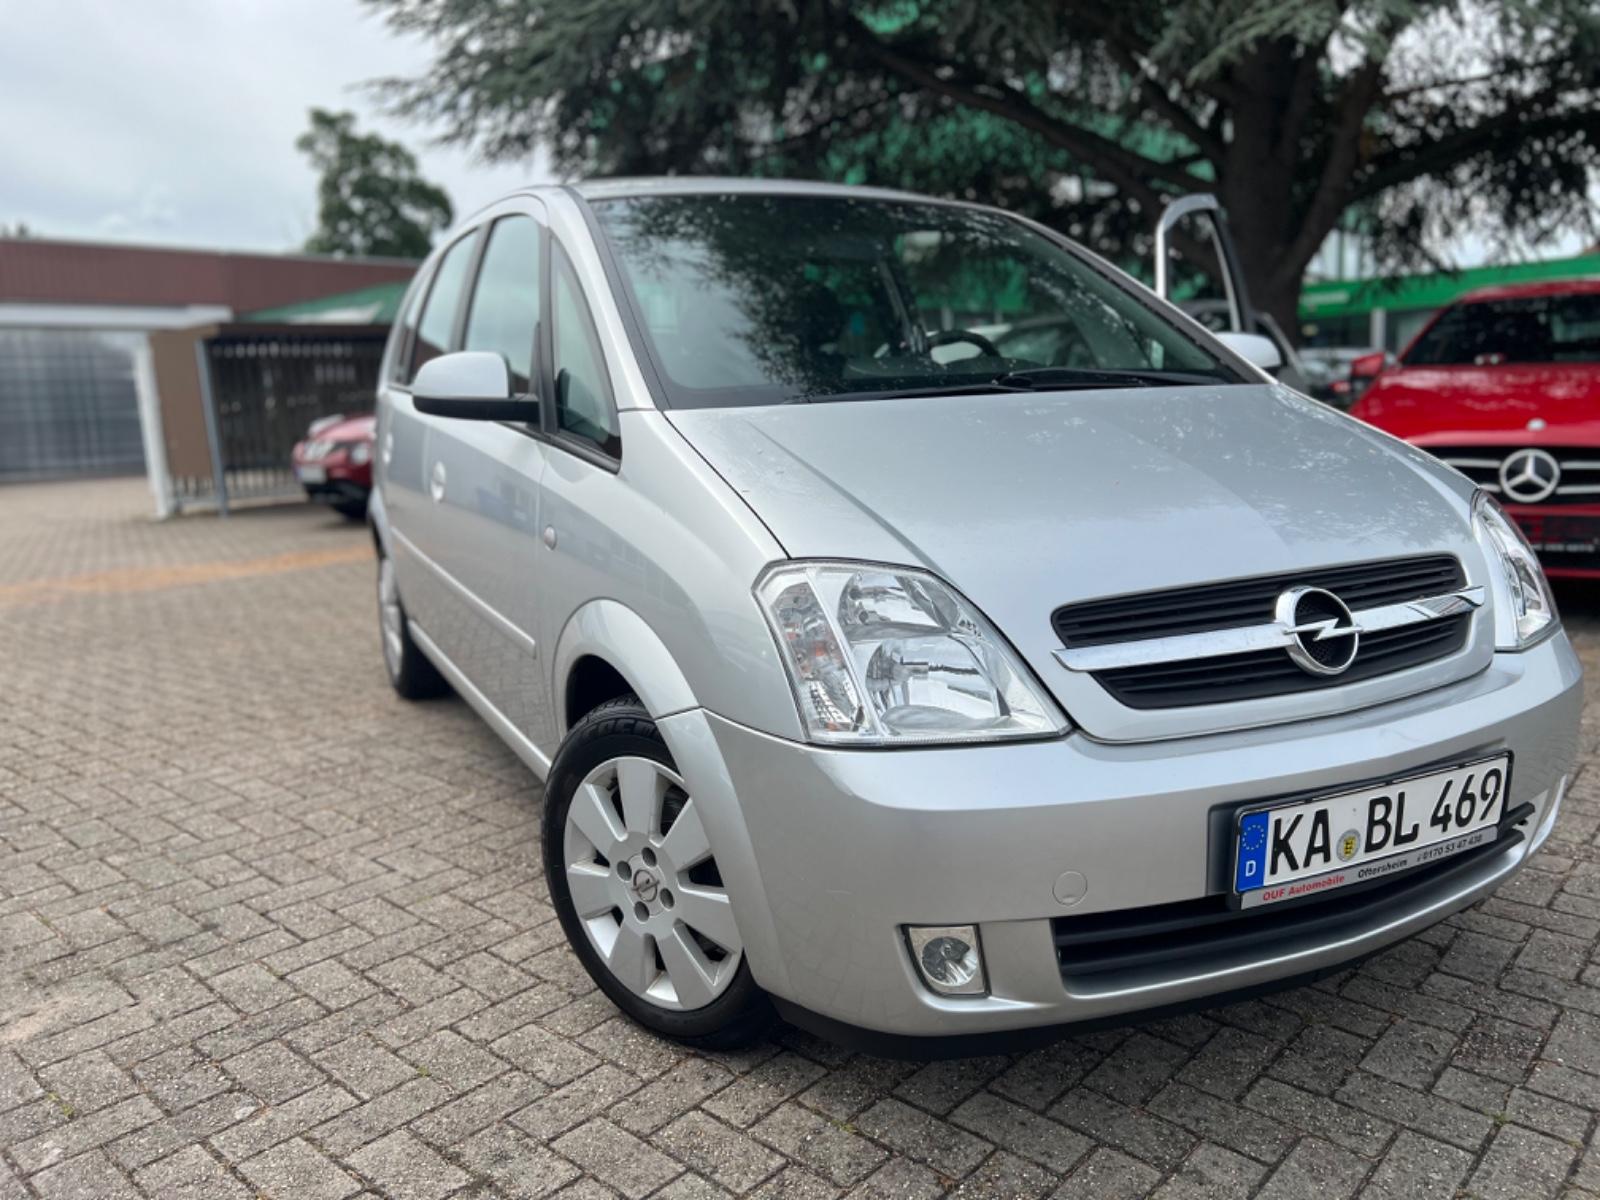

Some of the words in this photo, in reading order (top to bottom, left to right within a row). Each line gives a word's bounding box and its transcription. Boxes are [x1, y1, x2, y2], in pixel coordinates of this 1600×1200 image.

[1270, 809, 1331, 875] KA
[1364, 791, 1419, 853] BL
[1430, 768, 1502, 832] 469
[1245, 860, 1256, 877] D
[1263, 889, 1285, 901] OUF
[1288, 875, 1345, 896] Automobile
